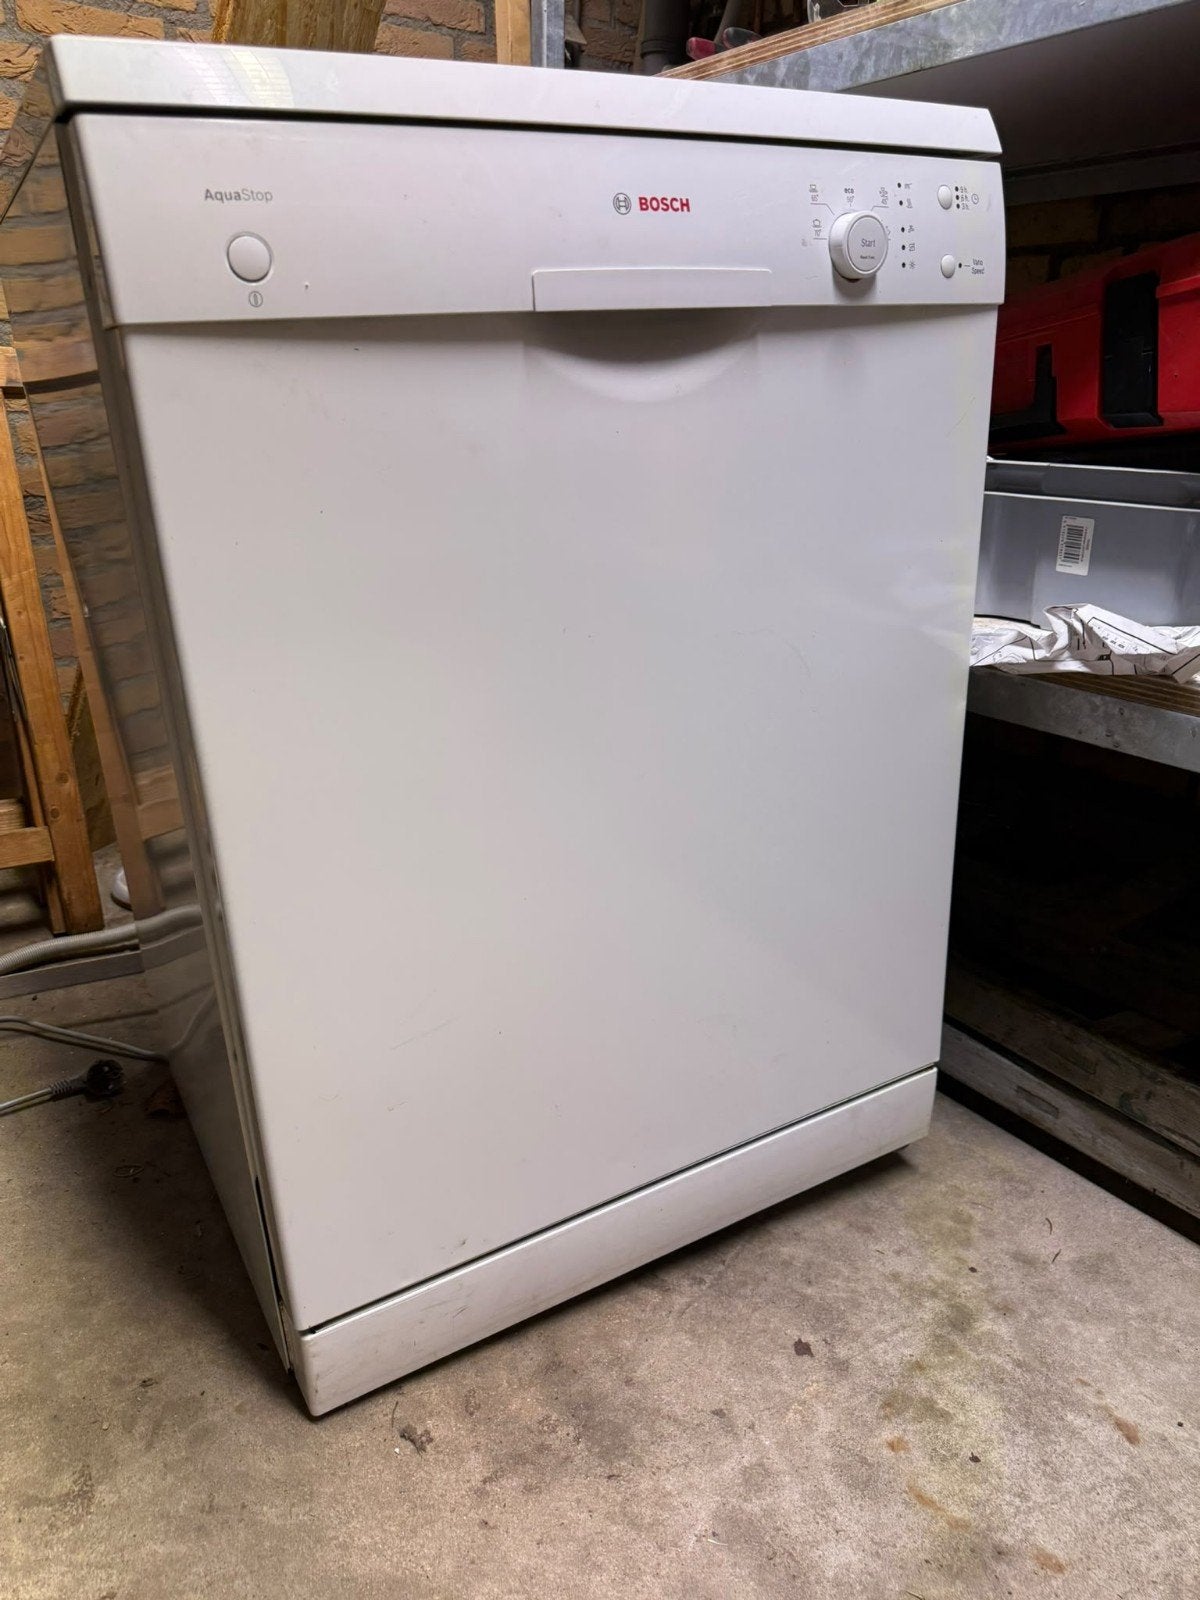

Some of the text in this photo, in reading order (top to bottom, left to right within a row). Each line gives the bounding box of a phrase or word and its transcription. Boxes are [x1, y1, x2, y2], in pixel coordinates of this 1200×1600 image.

[204, 188, 273, 204] AquaStop
[844, 187, 854, 195] eco
[638, 196, 691, 212] BOSCH
[861, 238, 876, 248] Start
